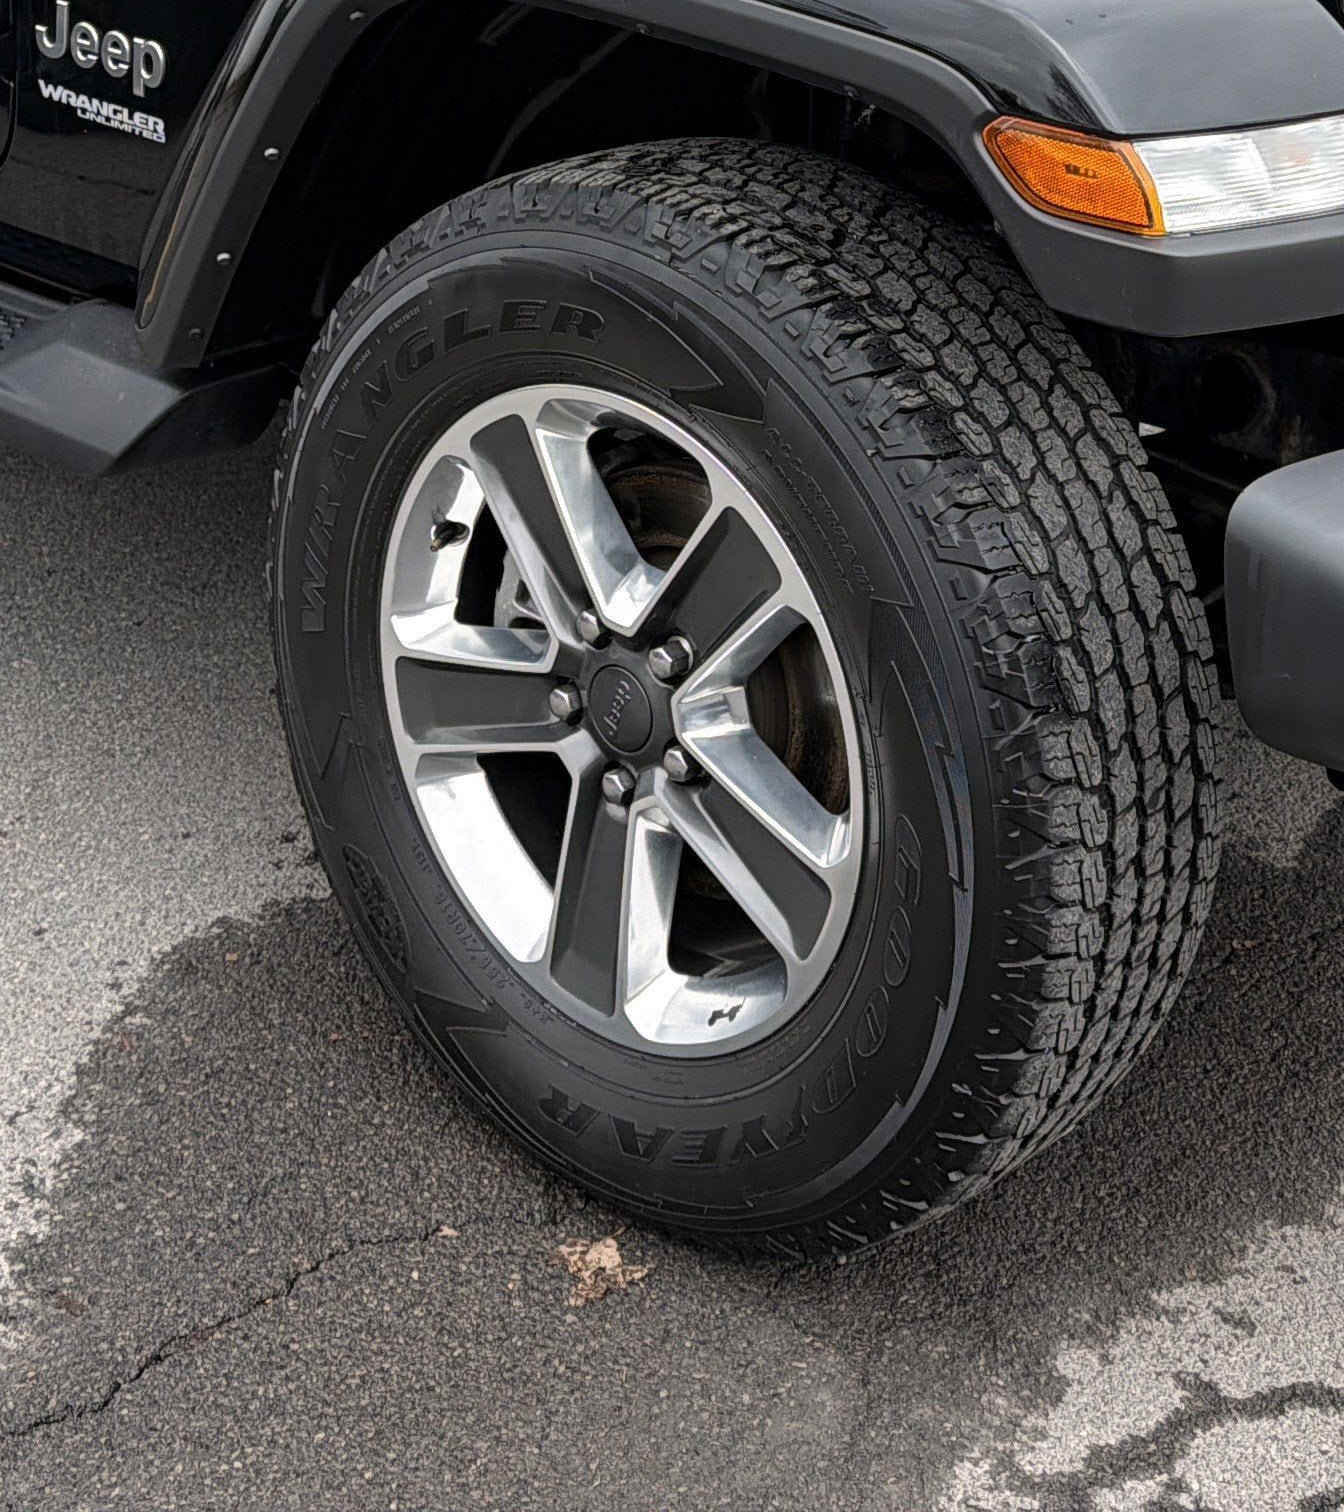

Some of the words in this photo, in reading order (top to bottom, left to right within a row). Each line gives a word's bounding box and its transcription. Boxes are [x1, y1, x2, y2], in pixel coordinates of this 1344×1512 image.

[34, 0, 166, 98] Jeep
[37, 78, 166, 134] WRANGLER
[76, 107, 166, 143] UNLIMITED
[301, 298, 608, 633] WRANGLER
[535, 814, 923, 1169] GOODYEAR
